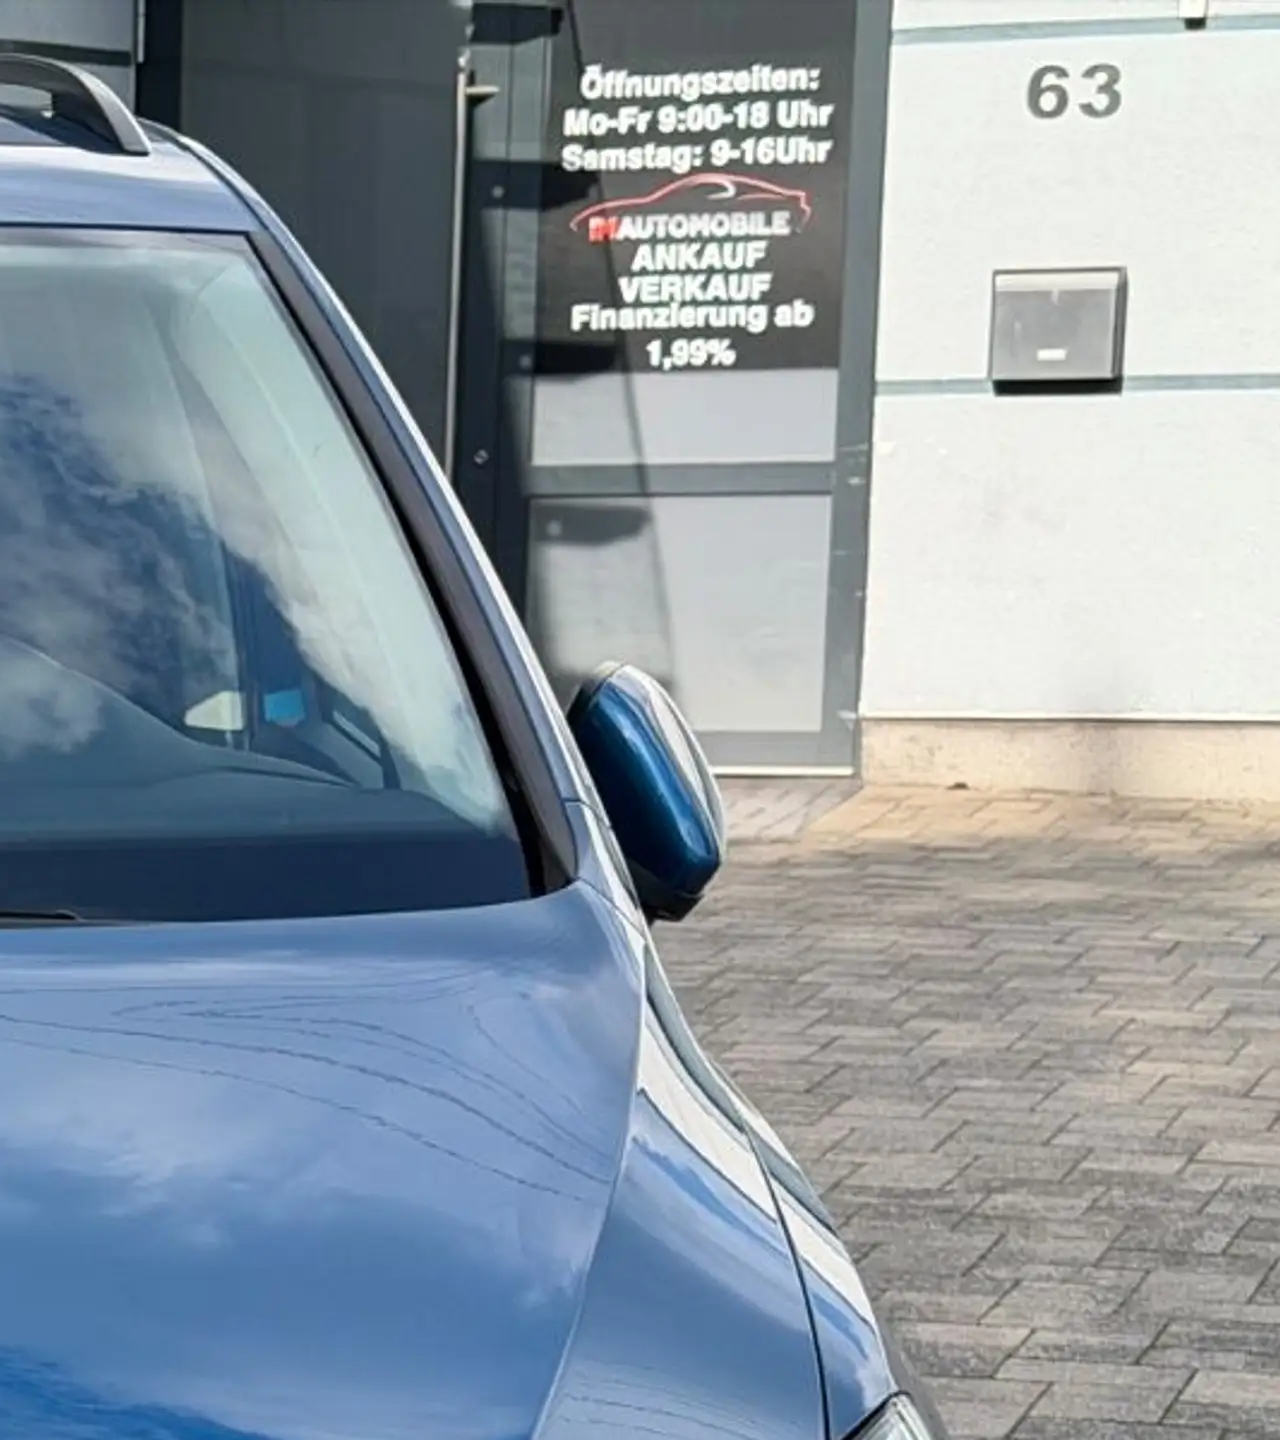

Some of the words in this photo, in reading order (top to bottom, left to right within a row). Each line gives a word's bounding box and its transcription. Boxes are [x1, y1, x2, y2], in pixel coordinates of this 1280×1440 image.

[581, 64, 820, 101] Öffnungszeiten:
[1027, 63, 1122, 119] 63
[563, 106, 651, 136] Mo-Fr
[657, 101, 770, 133] 9:00-18
[776, 99, 834, 127] Uhr
[561, 143, 703, 173] Samstag:
[709, 135, 833, 166] 9-16Uhr
[630, 241, 769, 272] ANKAUF
[618, 272, 773, 303] VERKAUF
[570, 301, 768, 333] Finanzierung
[773, 299, 816, 328] ab
[646, 338, 736, 370] 1,99%
